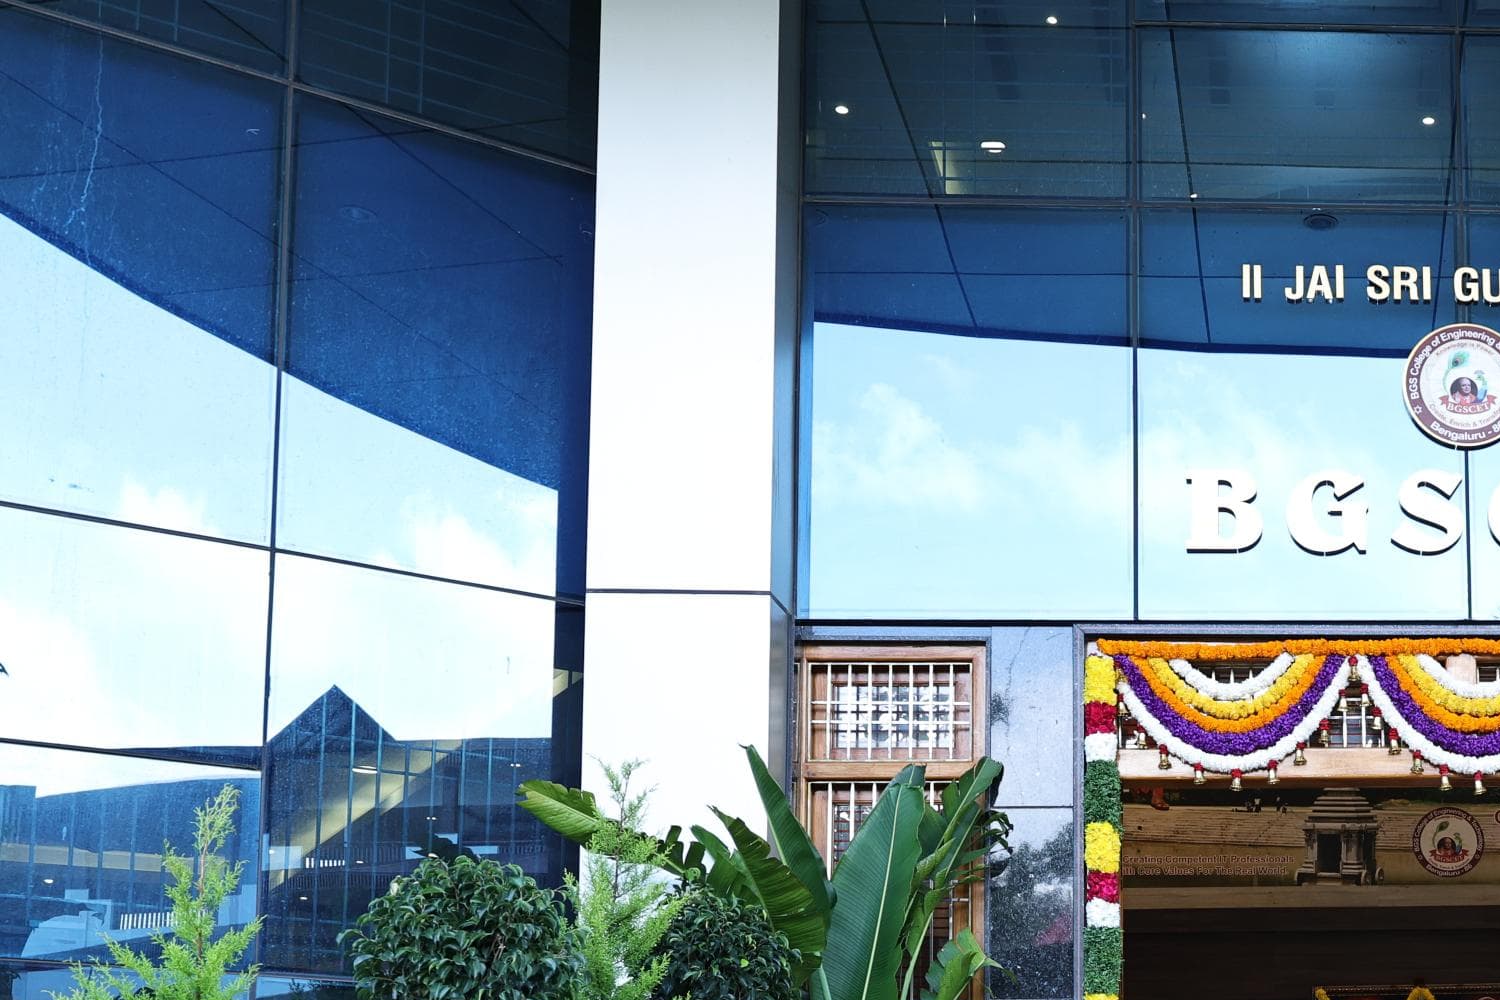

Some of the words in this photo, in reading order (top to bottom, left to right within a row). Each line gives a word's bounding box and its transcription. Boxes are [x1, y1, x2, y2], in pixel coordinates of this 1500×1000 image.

[1285, 265, 1345, 301] JAI
[1366, 265, 1432, 301] SRI
[1432, 335, 1440, 346] of
[1440, 329, 1497, 345] Engineering
[1410, 345, 1432, 374] College
[1408, 378, 1419, 400] BGS
[1447, 401, 1490, 414] BGSCET
[1430, 420, 1486, 441] Bengaluru
